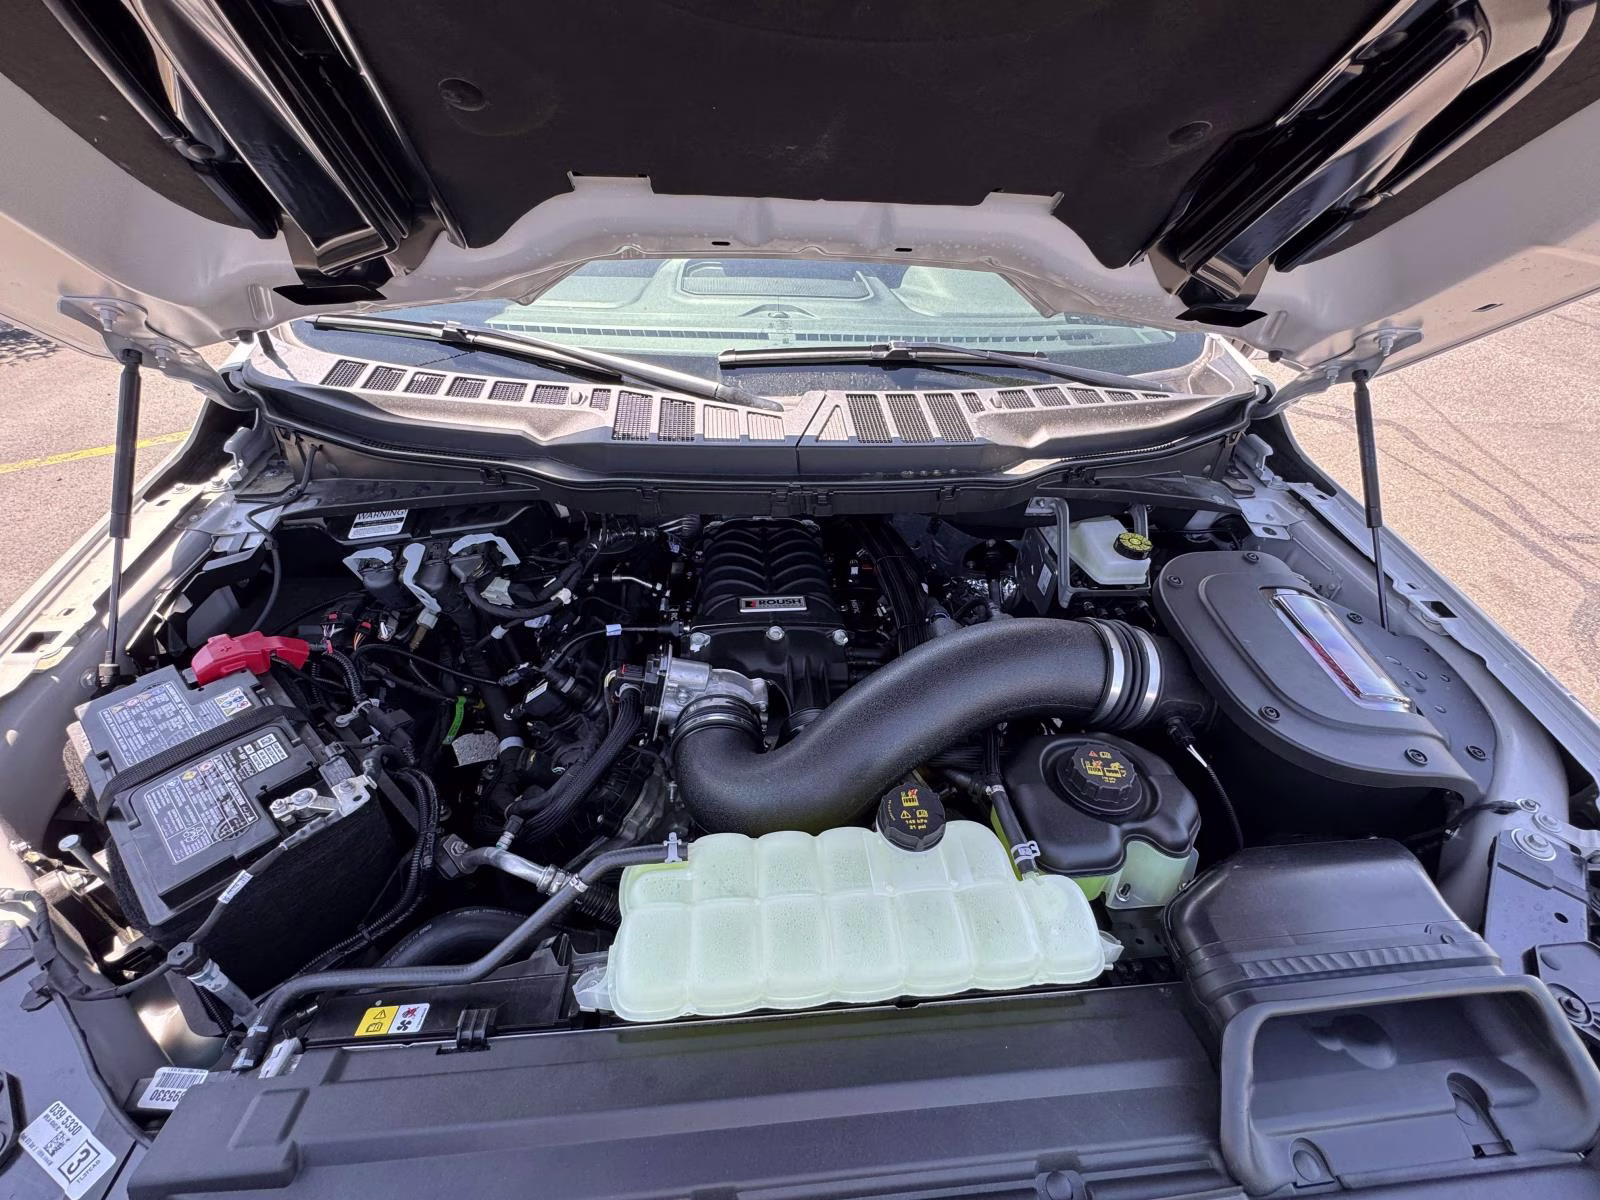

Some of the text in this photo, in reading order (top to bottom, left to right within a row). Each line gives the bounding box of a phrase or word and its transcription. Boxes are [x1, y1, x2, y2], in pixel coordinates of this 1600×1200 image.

[759, 598, 802, 606] ROUSH
[49, 1102, 67, 1120] 039
[61, 1115, 83, 1136] 5330
[66, 1148, 91, 1176] 3
